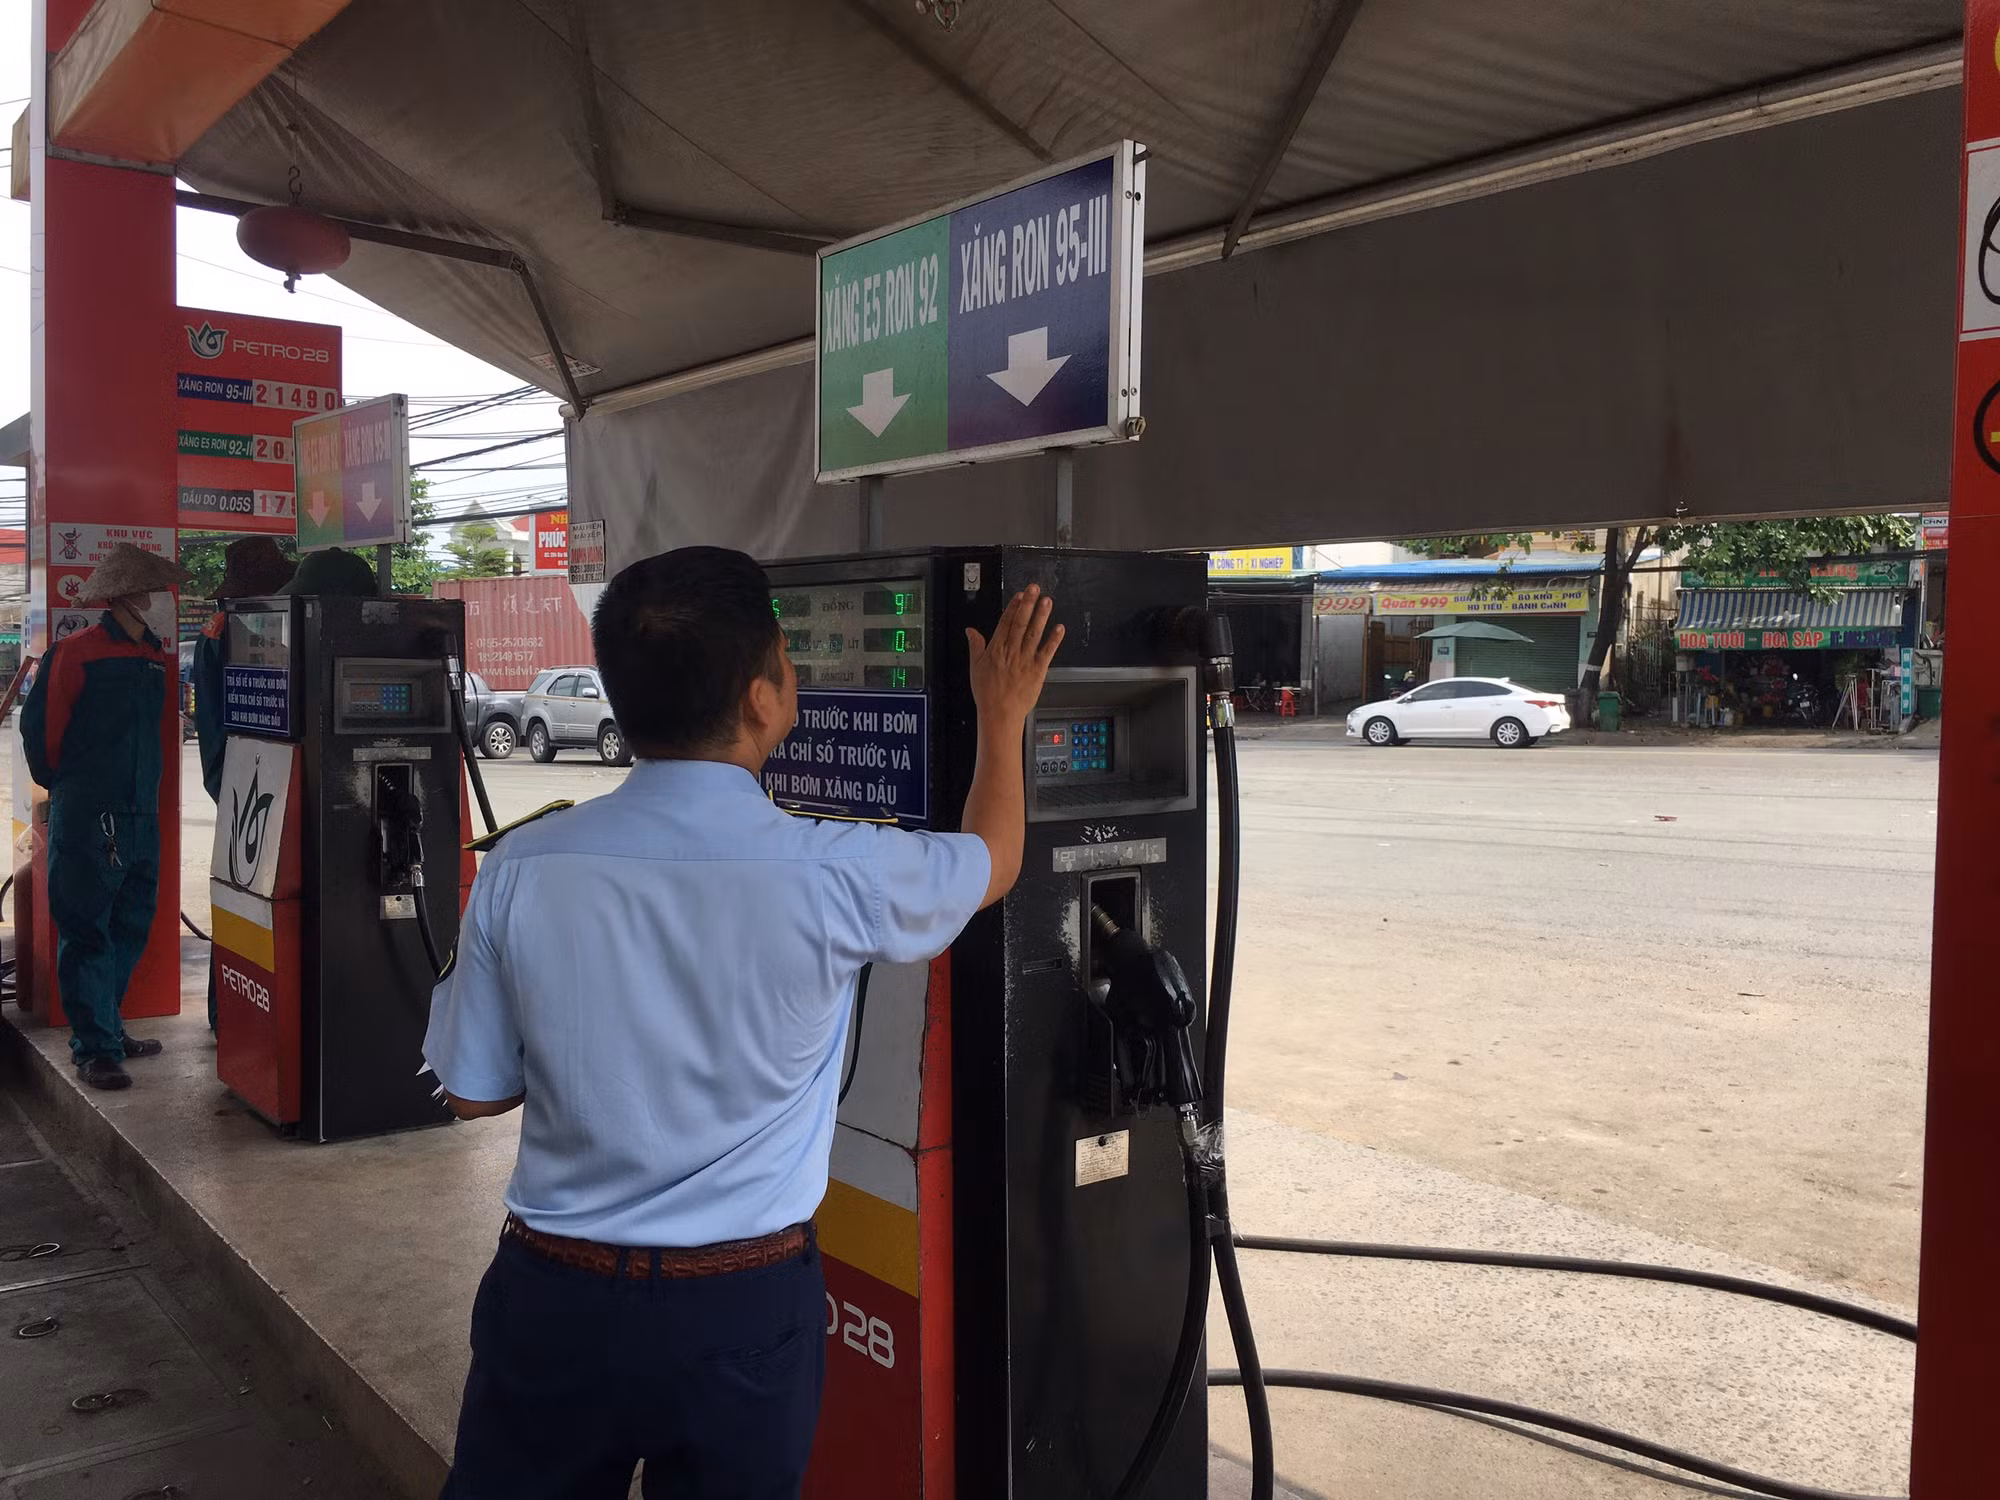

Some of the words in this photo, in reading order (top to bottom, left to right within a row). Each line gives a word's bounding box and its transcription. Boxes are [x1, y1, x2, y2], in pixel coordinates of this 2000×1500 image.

[959, 223, 1006, 314] XĂNG
[1011, 214, 1050, 299] RON
[1056, 194, 1107, 286] 95-III
[824, 273, 860, 353] XĂNG
[863, 273, 881, 343] E5
[885, 261, 914, 336] RON
[919, 253, 938, 327] 92
[178, 377, 203, 392] XĂNG
[204, 381, 223, 394] RON
[256, 383, 335, 411] 21490
[178, 433, 200, 448] XĂNG
[201, 437, 210, 448] E5
[211, 438, 227, 450] RON
[203, 493, 217, 506] DO
[219, 496, 251, 513] 0.05S
[106, 528, 128, 538] KHU
[538, 528, 566, 548] PHÚC
[1316, 596, 1367, 611] 999
[1419, 596, 1448, 609] 999
[1679, 633, 1709, 649] HOA
[1762, 631, 1788, 648] HOA
[1792, 628, 1824, 648] SÁP
[803, 705, 848, 730] TRƯỚC
[853, 711, 878, 732] KHI
[883, 710, 917, 735] BƠM
[790, 736, 812, 762] CHỈ
[816, 737, 835, 764] SỐ
[838, 742, 887, 768] TRƯỚC
[891, 744, 911, 771] VÀ
[765, 772, 787, 792] KHI
[791, 773, 821, 797] BƠM
[825, 776, 862, 801] XĂNG
[867, 775, 897, 805] DẦU
